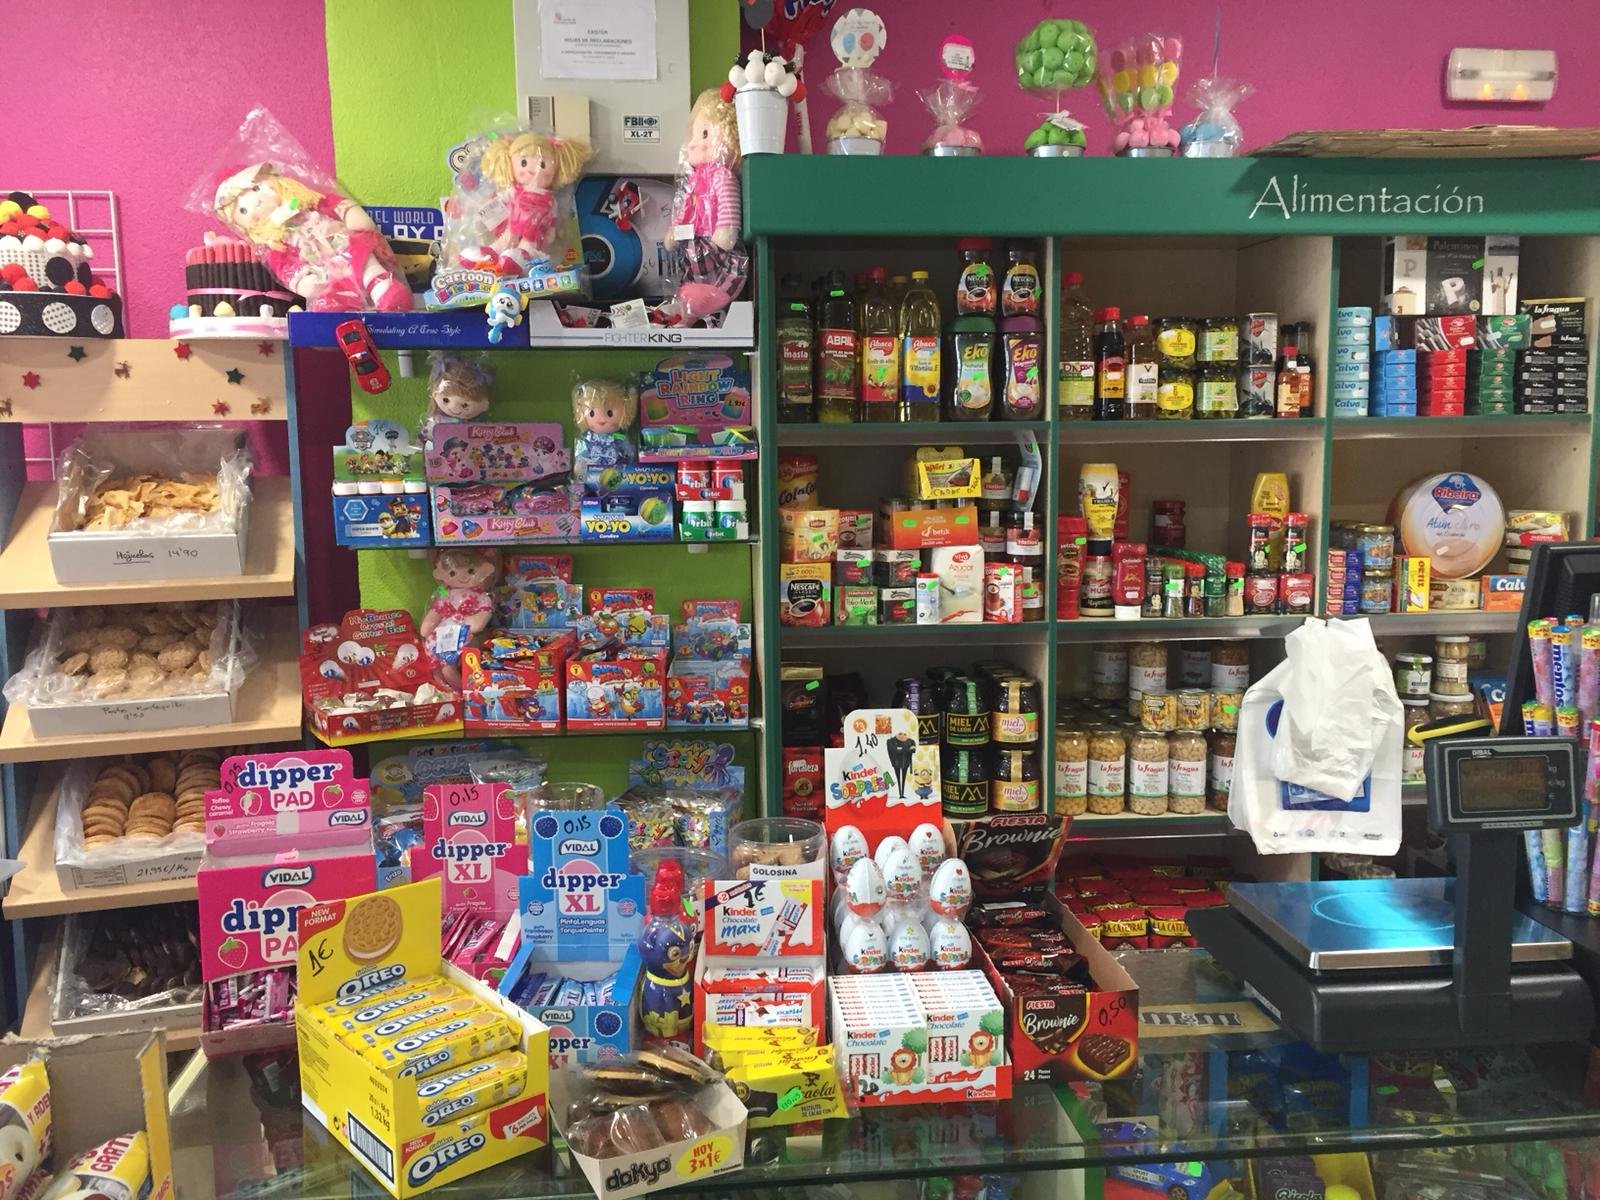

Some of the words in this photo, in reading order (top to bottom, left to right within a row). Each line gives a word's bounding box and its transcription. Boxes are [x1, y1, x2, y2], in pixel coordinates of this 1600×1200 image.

[630, 130, 653, 138] XL-2T
[1248, 175, 1484, 219] Alimentación
[394, 211, 433, 224] WORLD
[434, 271, 494, 289] Cartoon
[826, 335, 854, 346] ABRIL
[964, 344, 988, 360] Eko
[1014, 346, 1038, 361] Eko
[671, 369, 719, 382] LIGHT
[657, 379, 733, 396] RAINBOW
[679, 394, 719, 407] RING
[701, 490, 721, 499] Orbit
[1433, 487, 1479, 500] Ribeira
[587, 520, 631, 534] YO-YO
[1553, 643, 1566, 708] mentos
[949, 716, 970, 727] MIEL
[238, 761, 336, 790] dipper
[830, 771, 895, 801] SORPRESA
[273, 791, 313, 808] PAD
[334, 811, 364, 822] VIDAL
[453, 815, 484, 825] VIDAL
[991, 816, 1046, 827] FIESTA
[963, 826, 1064, 853] Brownie
[432, 838, 507, 862] dipper
[564, 843, 597, 853] VIDAL
[268, 871, 309, 884] VIDAL
[454, 863, 488, 882] XL
[752, 867, 798, 877] GOLOSINA
[543, 867, 622, 893] dipper
[565, 894, 601, 913] XL
[304, 912, 337, 927] FORMAT
[311, 906, 330, 918] NEW
[721, 924, 761, 939] maxi
[338, 963, 405, 998] OREO
[354, 992, 425, 1022] OREO
[1026, 999, 1055, 1010] FIESTA
[374, 1006, 447, 1036] OREO
[543, 1010, 572, 1021] VIDAL
[1022, 1013, 1080, 1035] Brownie
[394, 1020, 468, 1052] OREO
[846, 1038, 888, 1048] Chocolate
[398, 1050, 450, 1079] OREO
[417, 1063, 490, 1097] OREO
[1023, 1070, 1035, 1081] 24
[422, 1096, 474, 1128] OREO
[511, 1123, 519, 1135] 6
[693, 1141, 714, 1156] HOY
[409, 1133, 486, 1185] OREO
